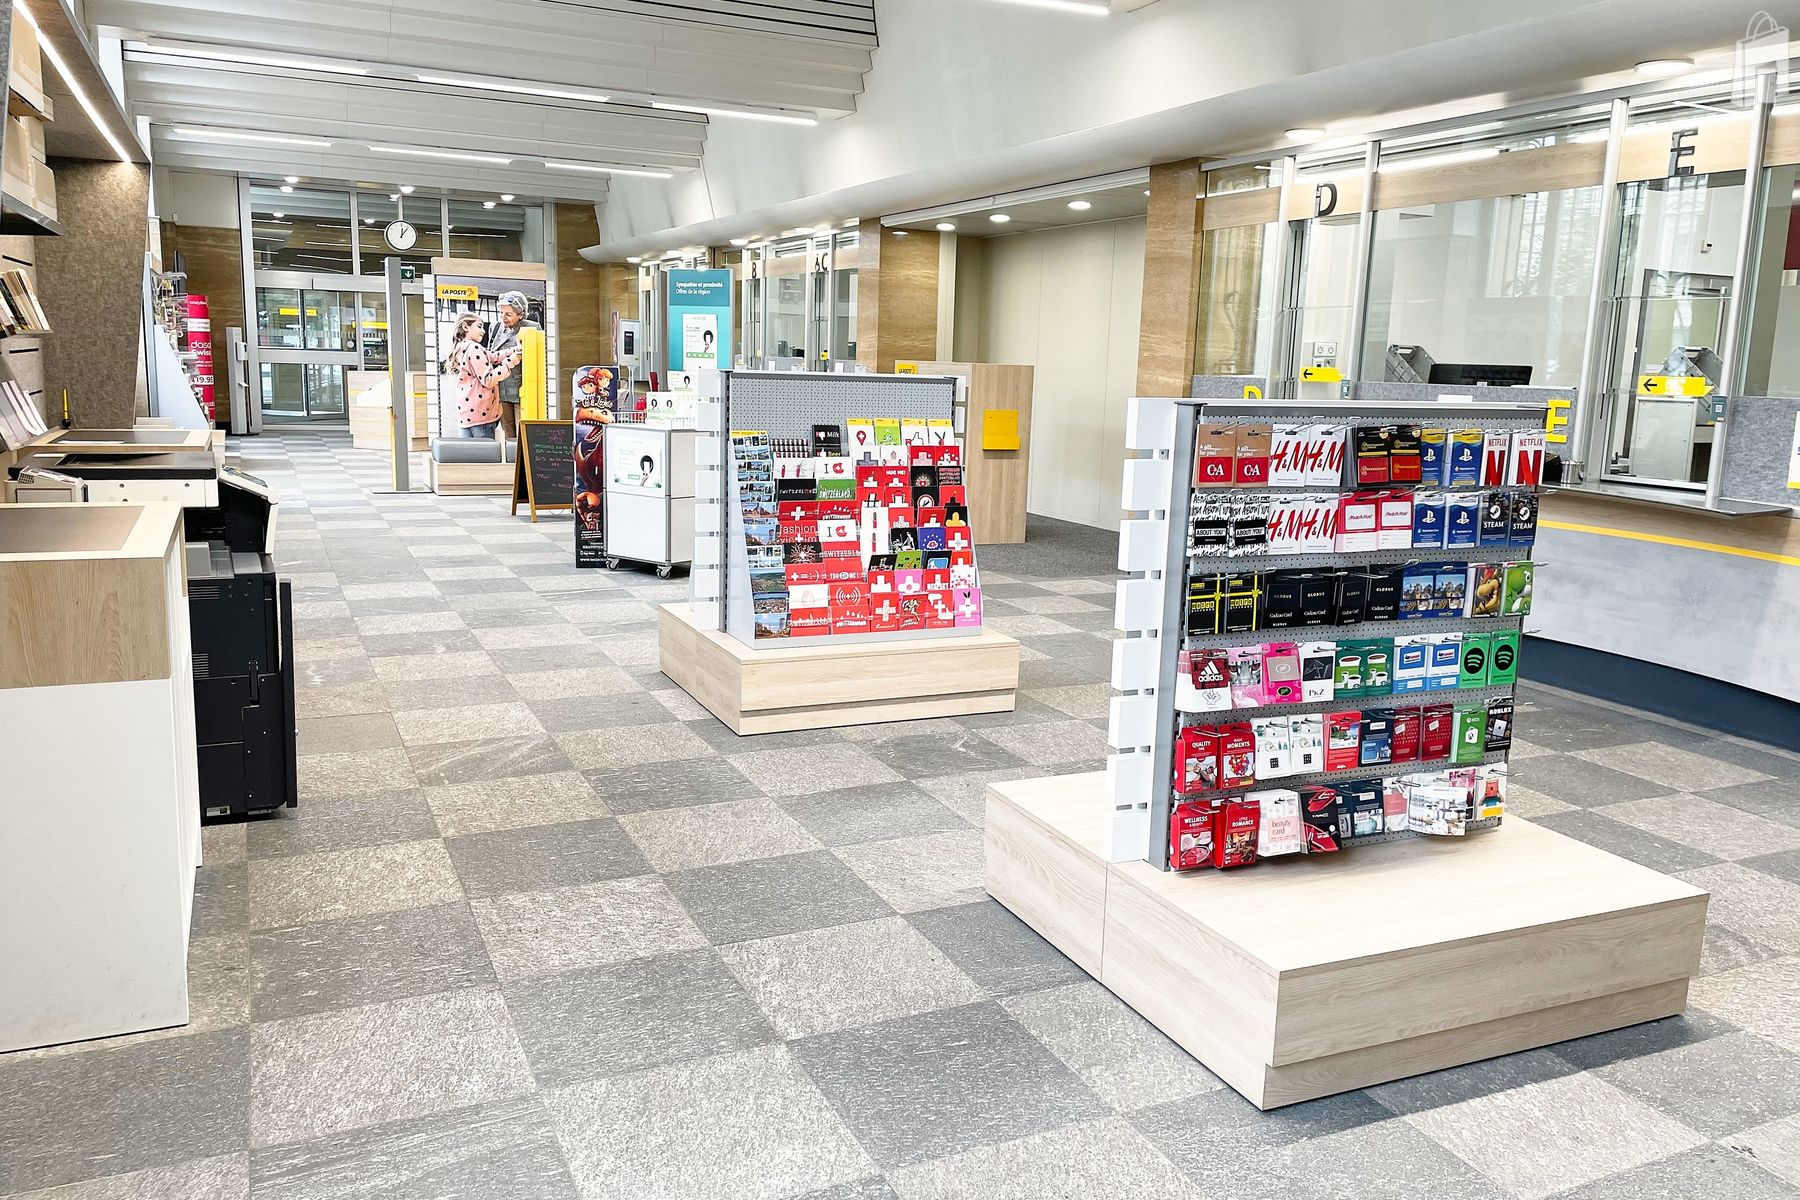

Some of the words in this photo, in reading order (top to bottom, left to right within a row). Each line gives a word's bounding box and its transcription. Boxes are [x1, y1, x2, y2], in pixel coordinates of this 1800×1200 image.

[1669, 128, 1698, 177] E
[1315, 183, 1338, 217] D
[1546, 399, 1571, 443] E
[1488, 438, 1508, 447] NETFLIX
[1519, 438, 1544, 447] NETFLIX
[1271, 440, 1309, 473] H&M
[1307, 440, 1345, 473] H&M
[1207, 464, 1224, 476] C&A
[1244, 464, 1261, 476] C&A
[1268, 509, 1305, 542] H&M
[1300, 508, 1339, 541] H&M
[1483, 521, 1504, 529] STEAM
[1236, 529, 1251, 537] ABOUT
[1198, 674, 1224, 684] adidas
[1191, 740, 1211, 748] QUALITY
[1227, 741, 1251, 749] MOMENTS
[1184, 816, 1208, 824] WELLNESS
[1232, 819, 1254, 828] ROMANCE
[1271, 819, 1291, 828] beauty
[1272, 827, 1285, 836] card
